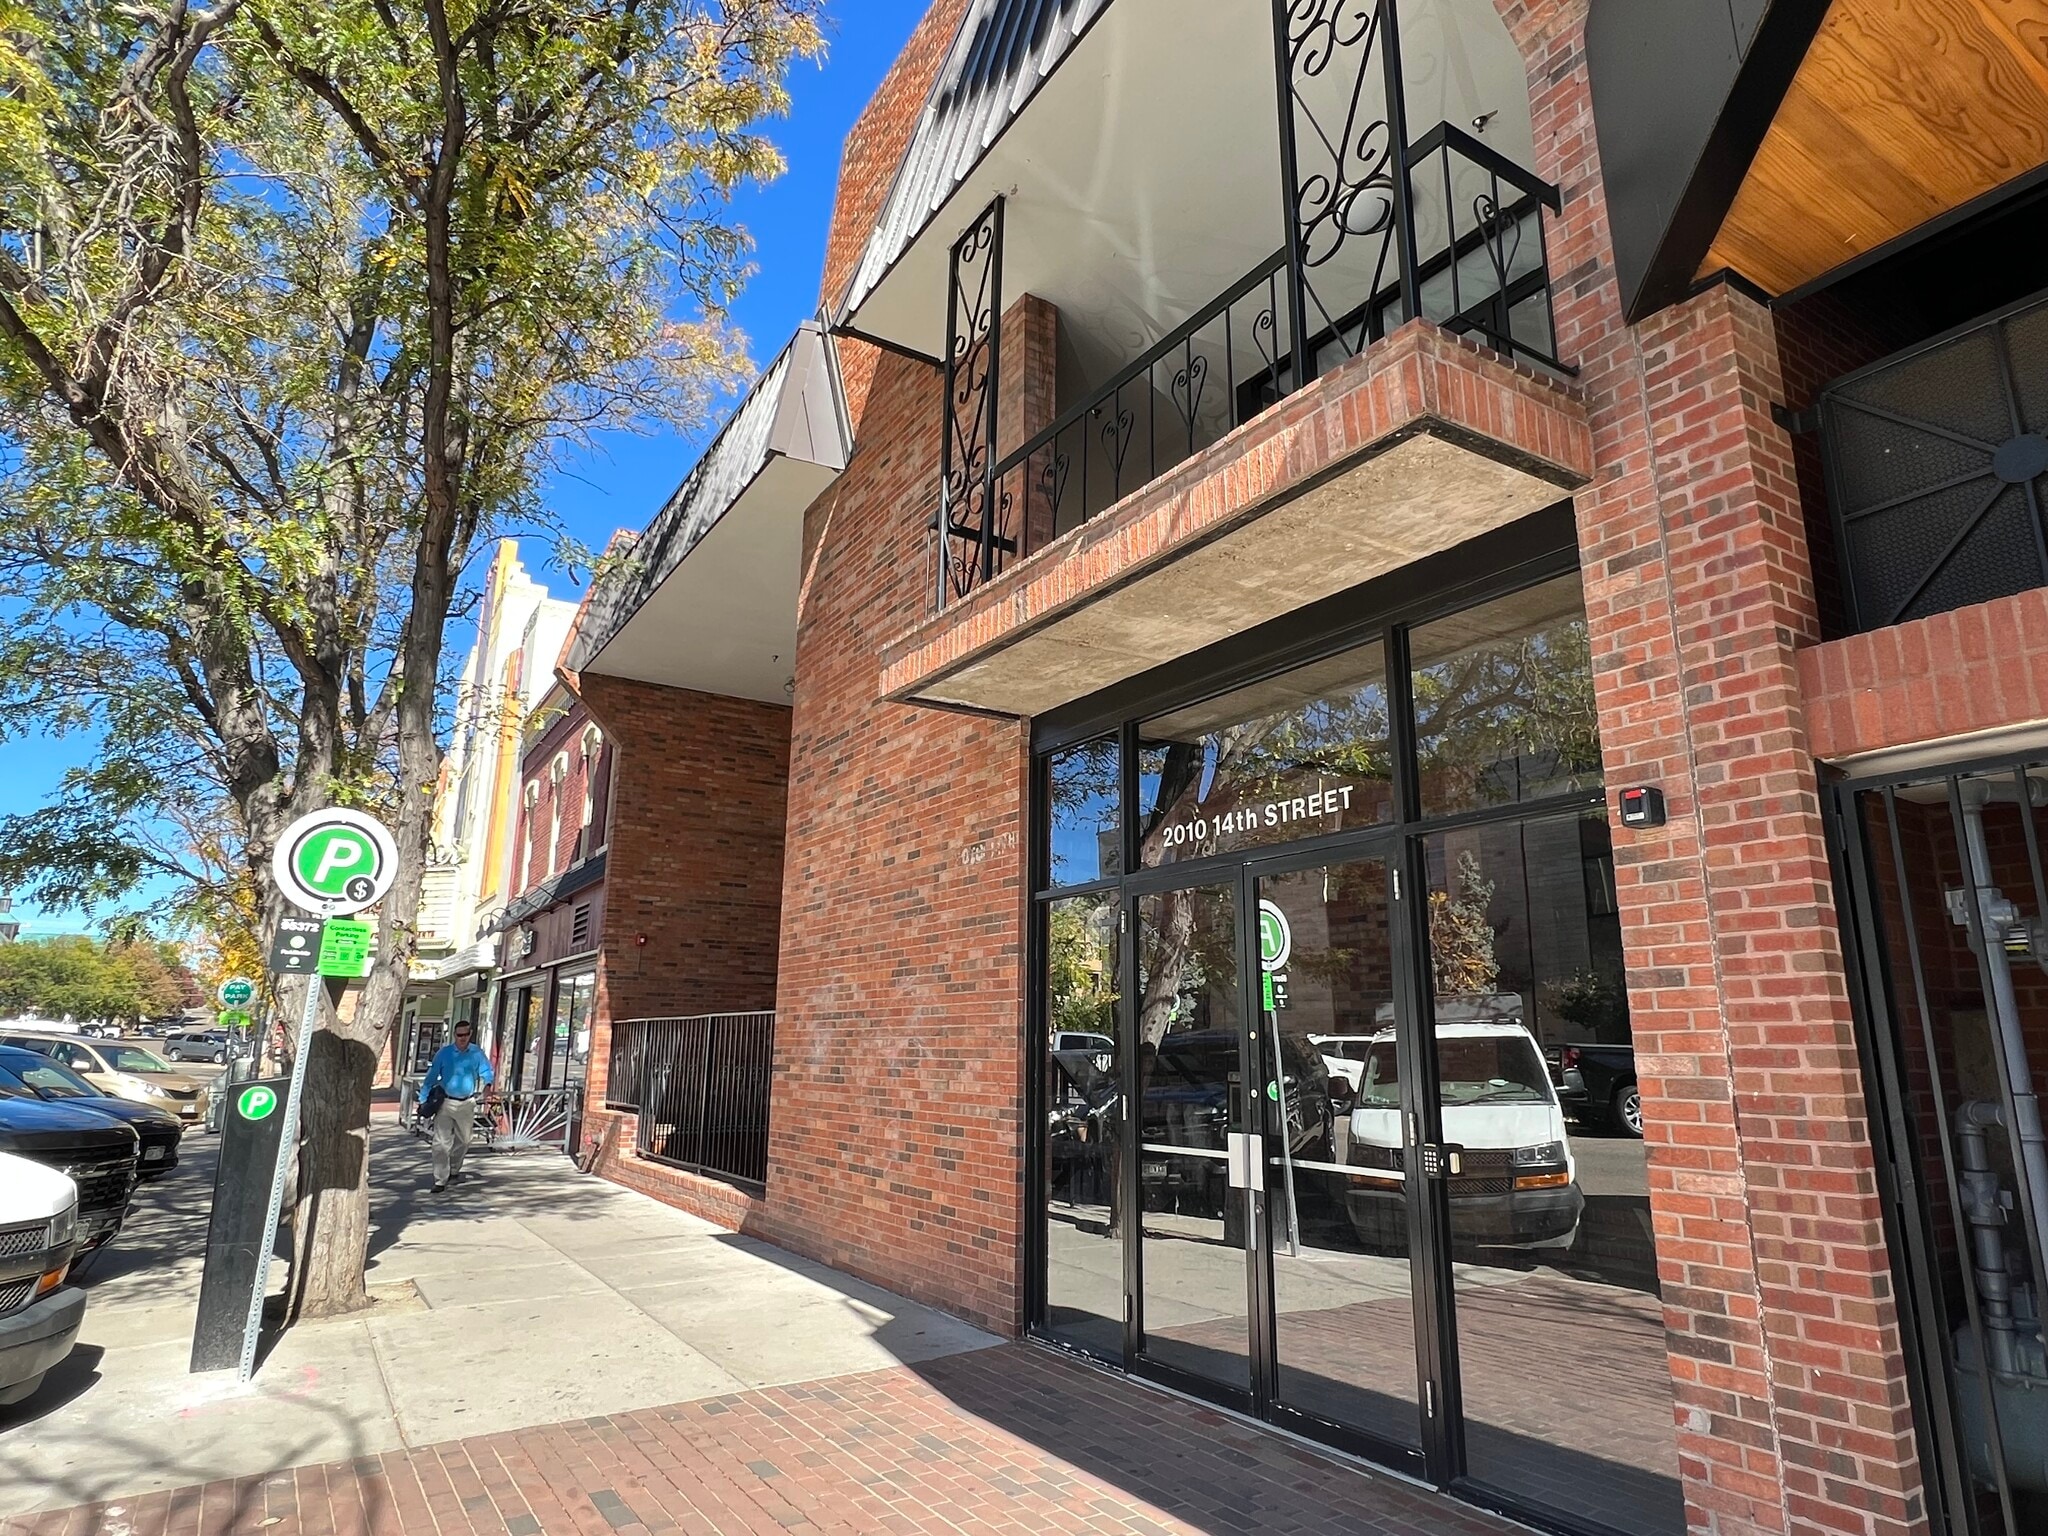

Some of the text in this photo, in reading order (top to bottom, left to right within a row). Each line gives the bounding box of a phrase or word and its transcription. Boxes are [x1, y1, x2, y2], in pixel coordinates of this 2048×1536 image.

[1163, 785, 1354, 848] 2010 14th STREET
[312, 837, 363, 883] P
[353, 880, 368, 900] $
[246, 1091, 269, 1114] P
